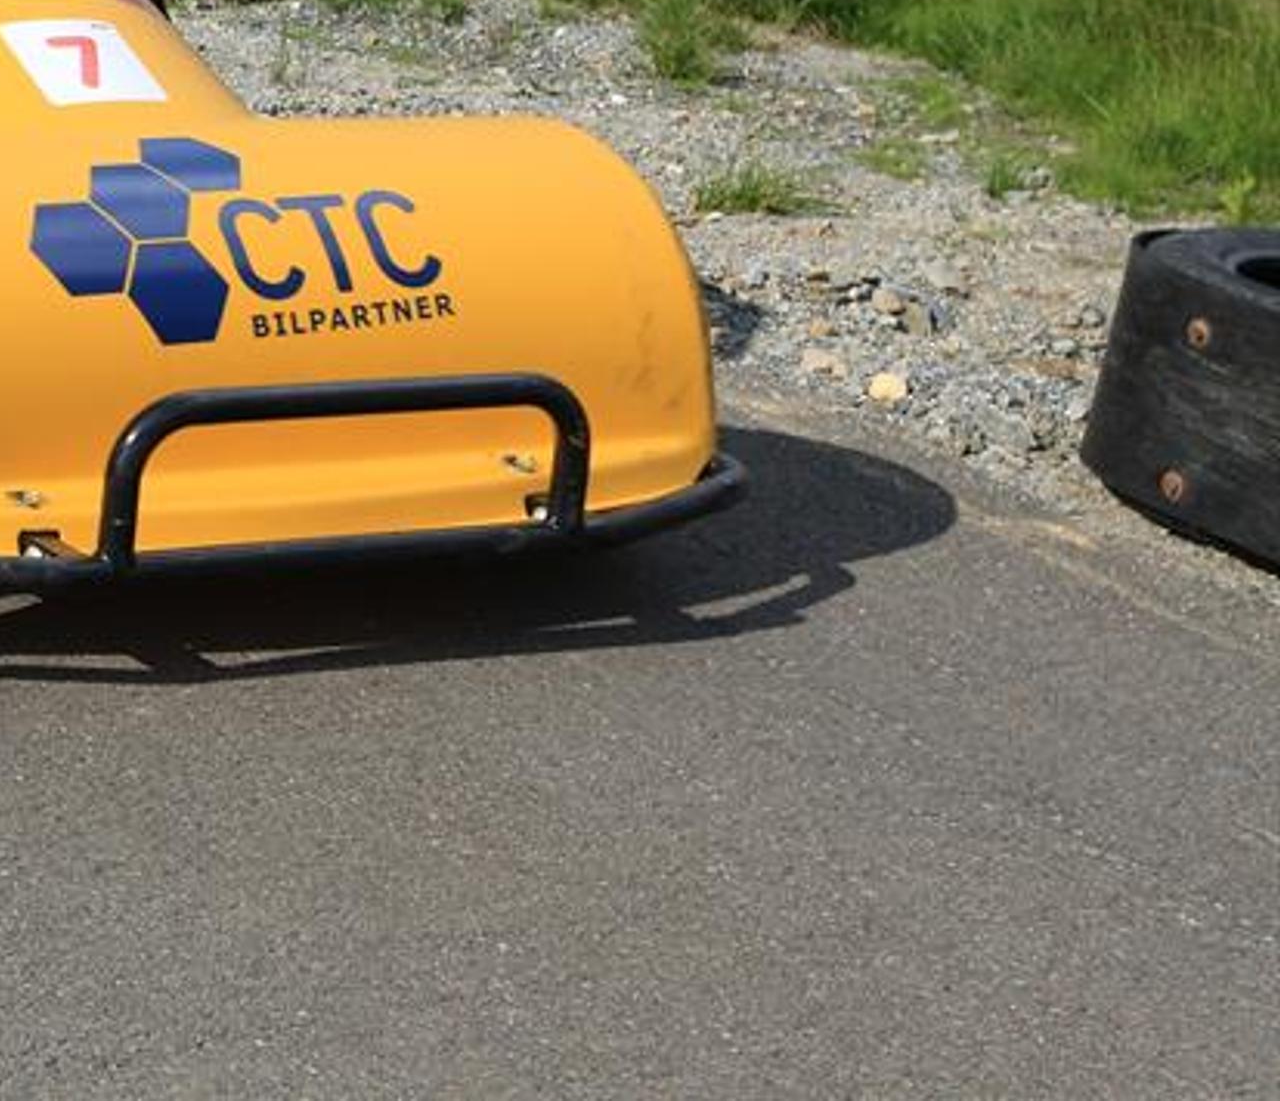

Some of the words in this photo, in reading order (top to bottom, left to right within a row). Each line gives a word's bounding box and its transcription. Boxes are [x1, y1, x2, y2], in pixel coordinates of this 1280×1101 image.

[45, 35, 100, 89] 7
[218, 189, 443, 301] CTC
[251, 293, 457, 338] BILPARTNER
